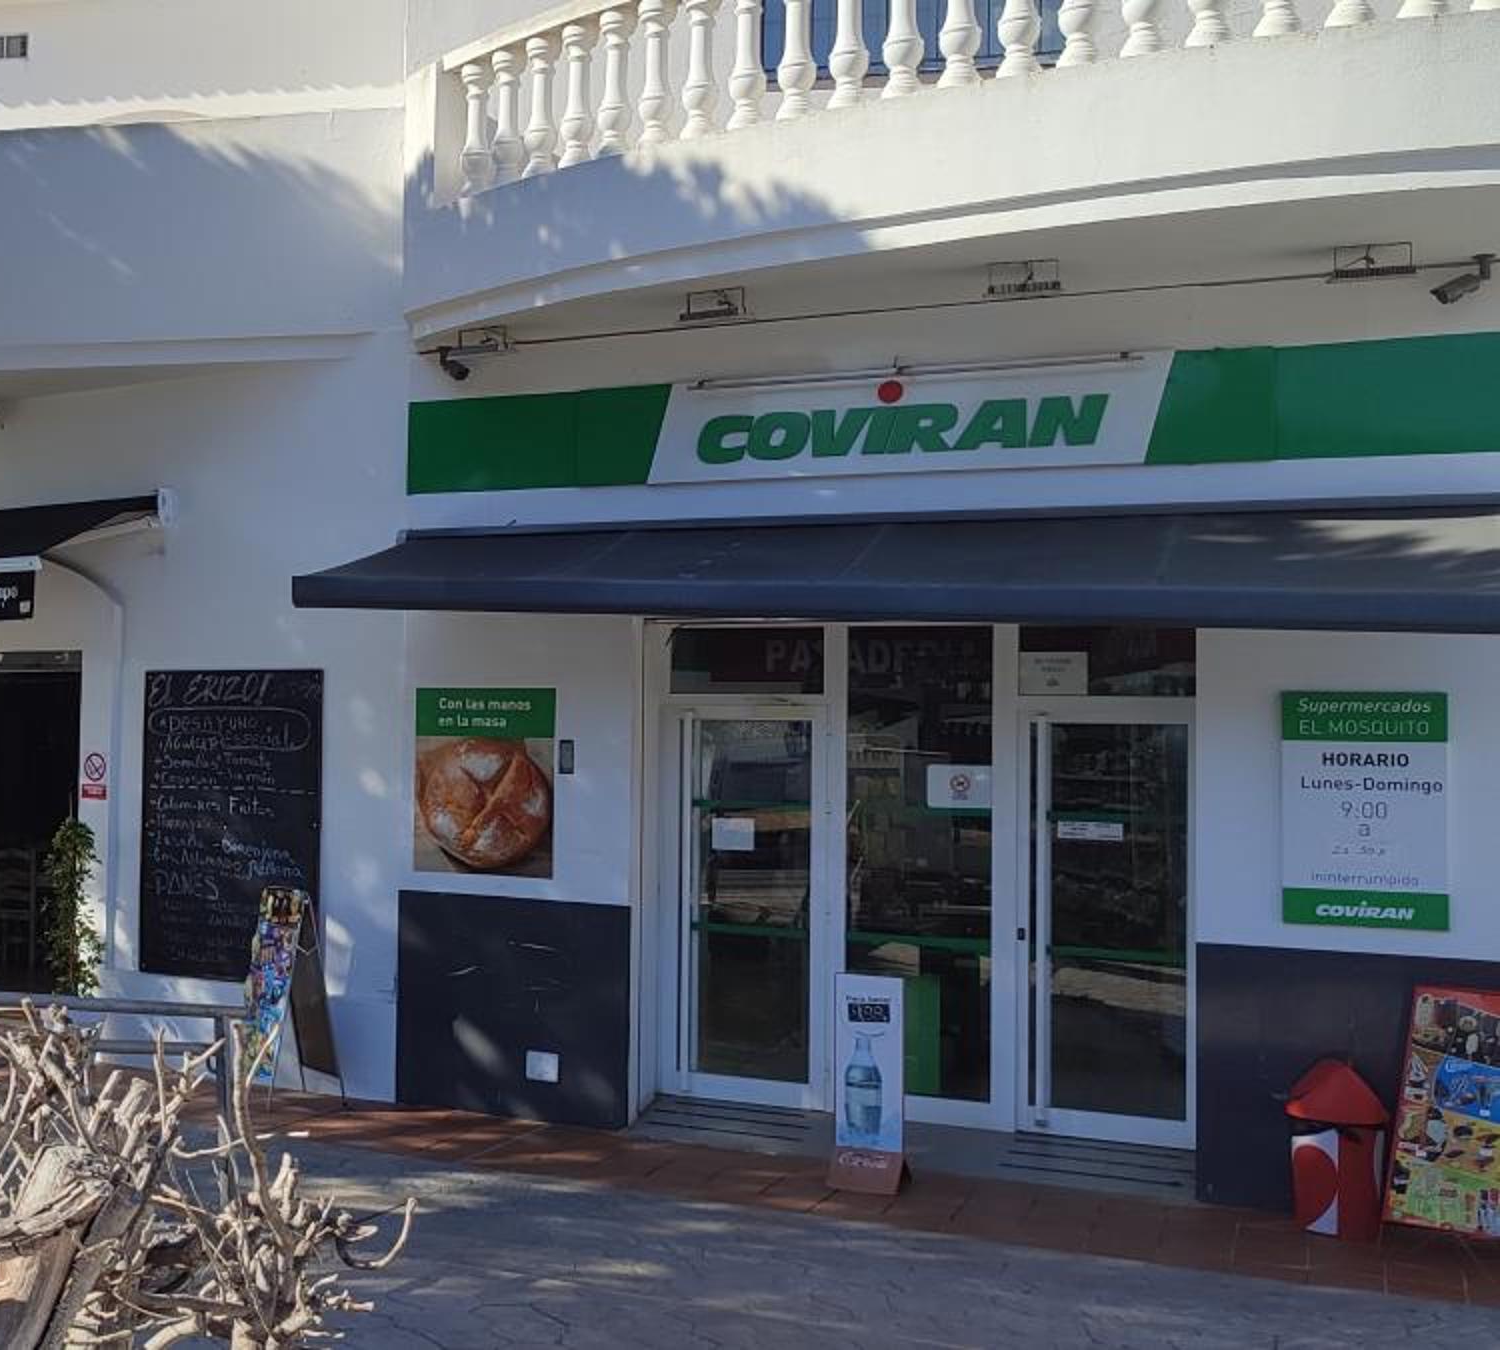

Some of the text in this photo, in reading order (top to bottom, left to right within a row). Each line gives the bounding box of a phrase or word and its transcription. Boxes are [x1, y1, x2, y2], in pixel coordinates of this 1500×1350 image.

[438, 697, 532, 711] Con las manos
[1297, 697, 1432, 714] Supermercados
[438, 714, 507, 728] en la masa
[1299, 719, 1429, 735] EL MOSQUITO
[1322, 752, 1409, 768] HORARIO
[1300, 775, 1443, 795] Lunes-Domingo
[1358, 823, 1371, 837] a
